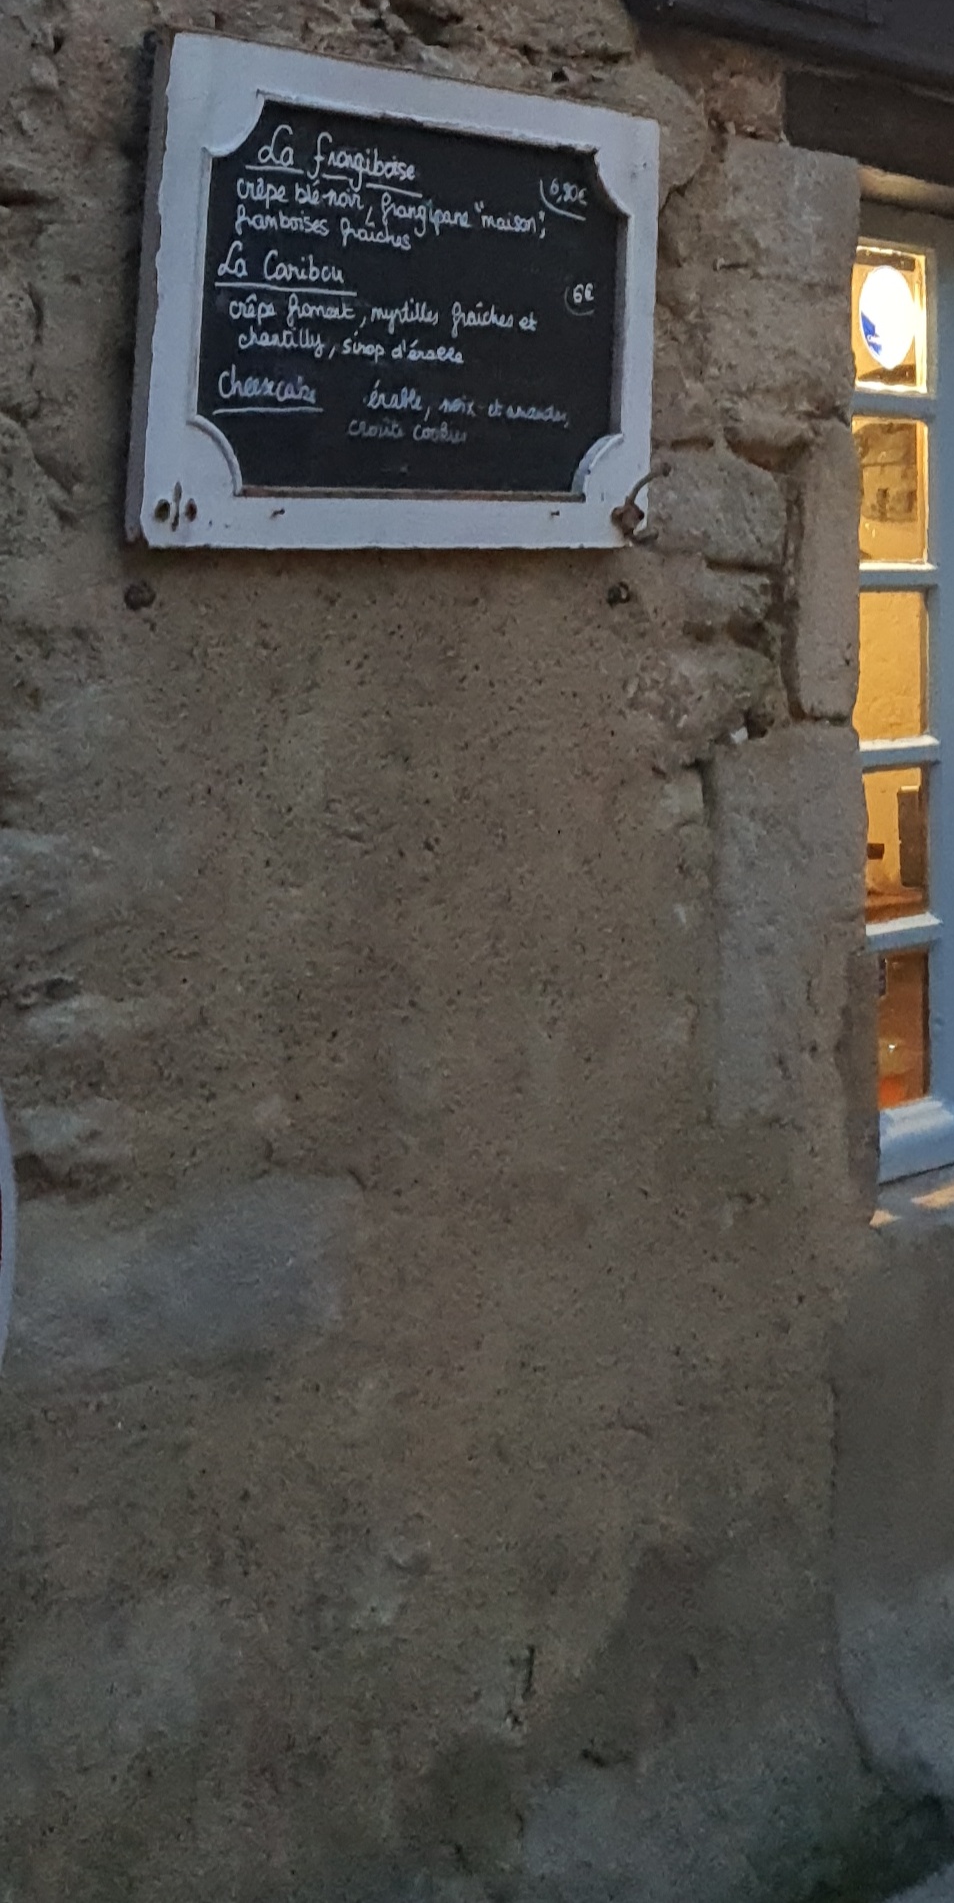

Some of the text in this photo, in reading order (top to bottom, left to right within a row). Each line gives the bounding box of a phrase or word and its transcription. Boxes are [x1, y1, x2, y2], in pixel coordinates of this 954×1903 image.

[257, 124, 294, 166] La
[234, 203, 330, 237] framboises
[217, 240, 345, 284] La Caribou
[518, 310, 539, 333] et
